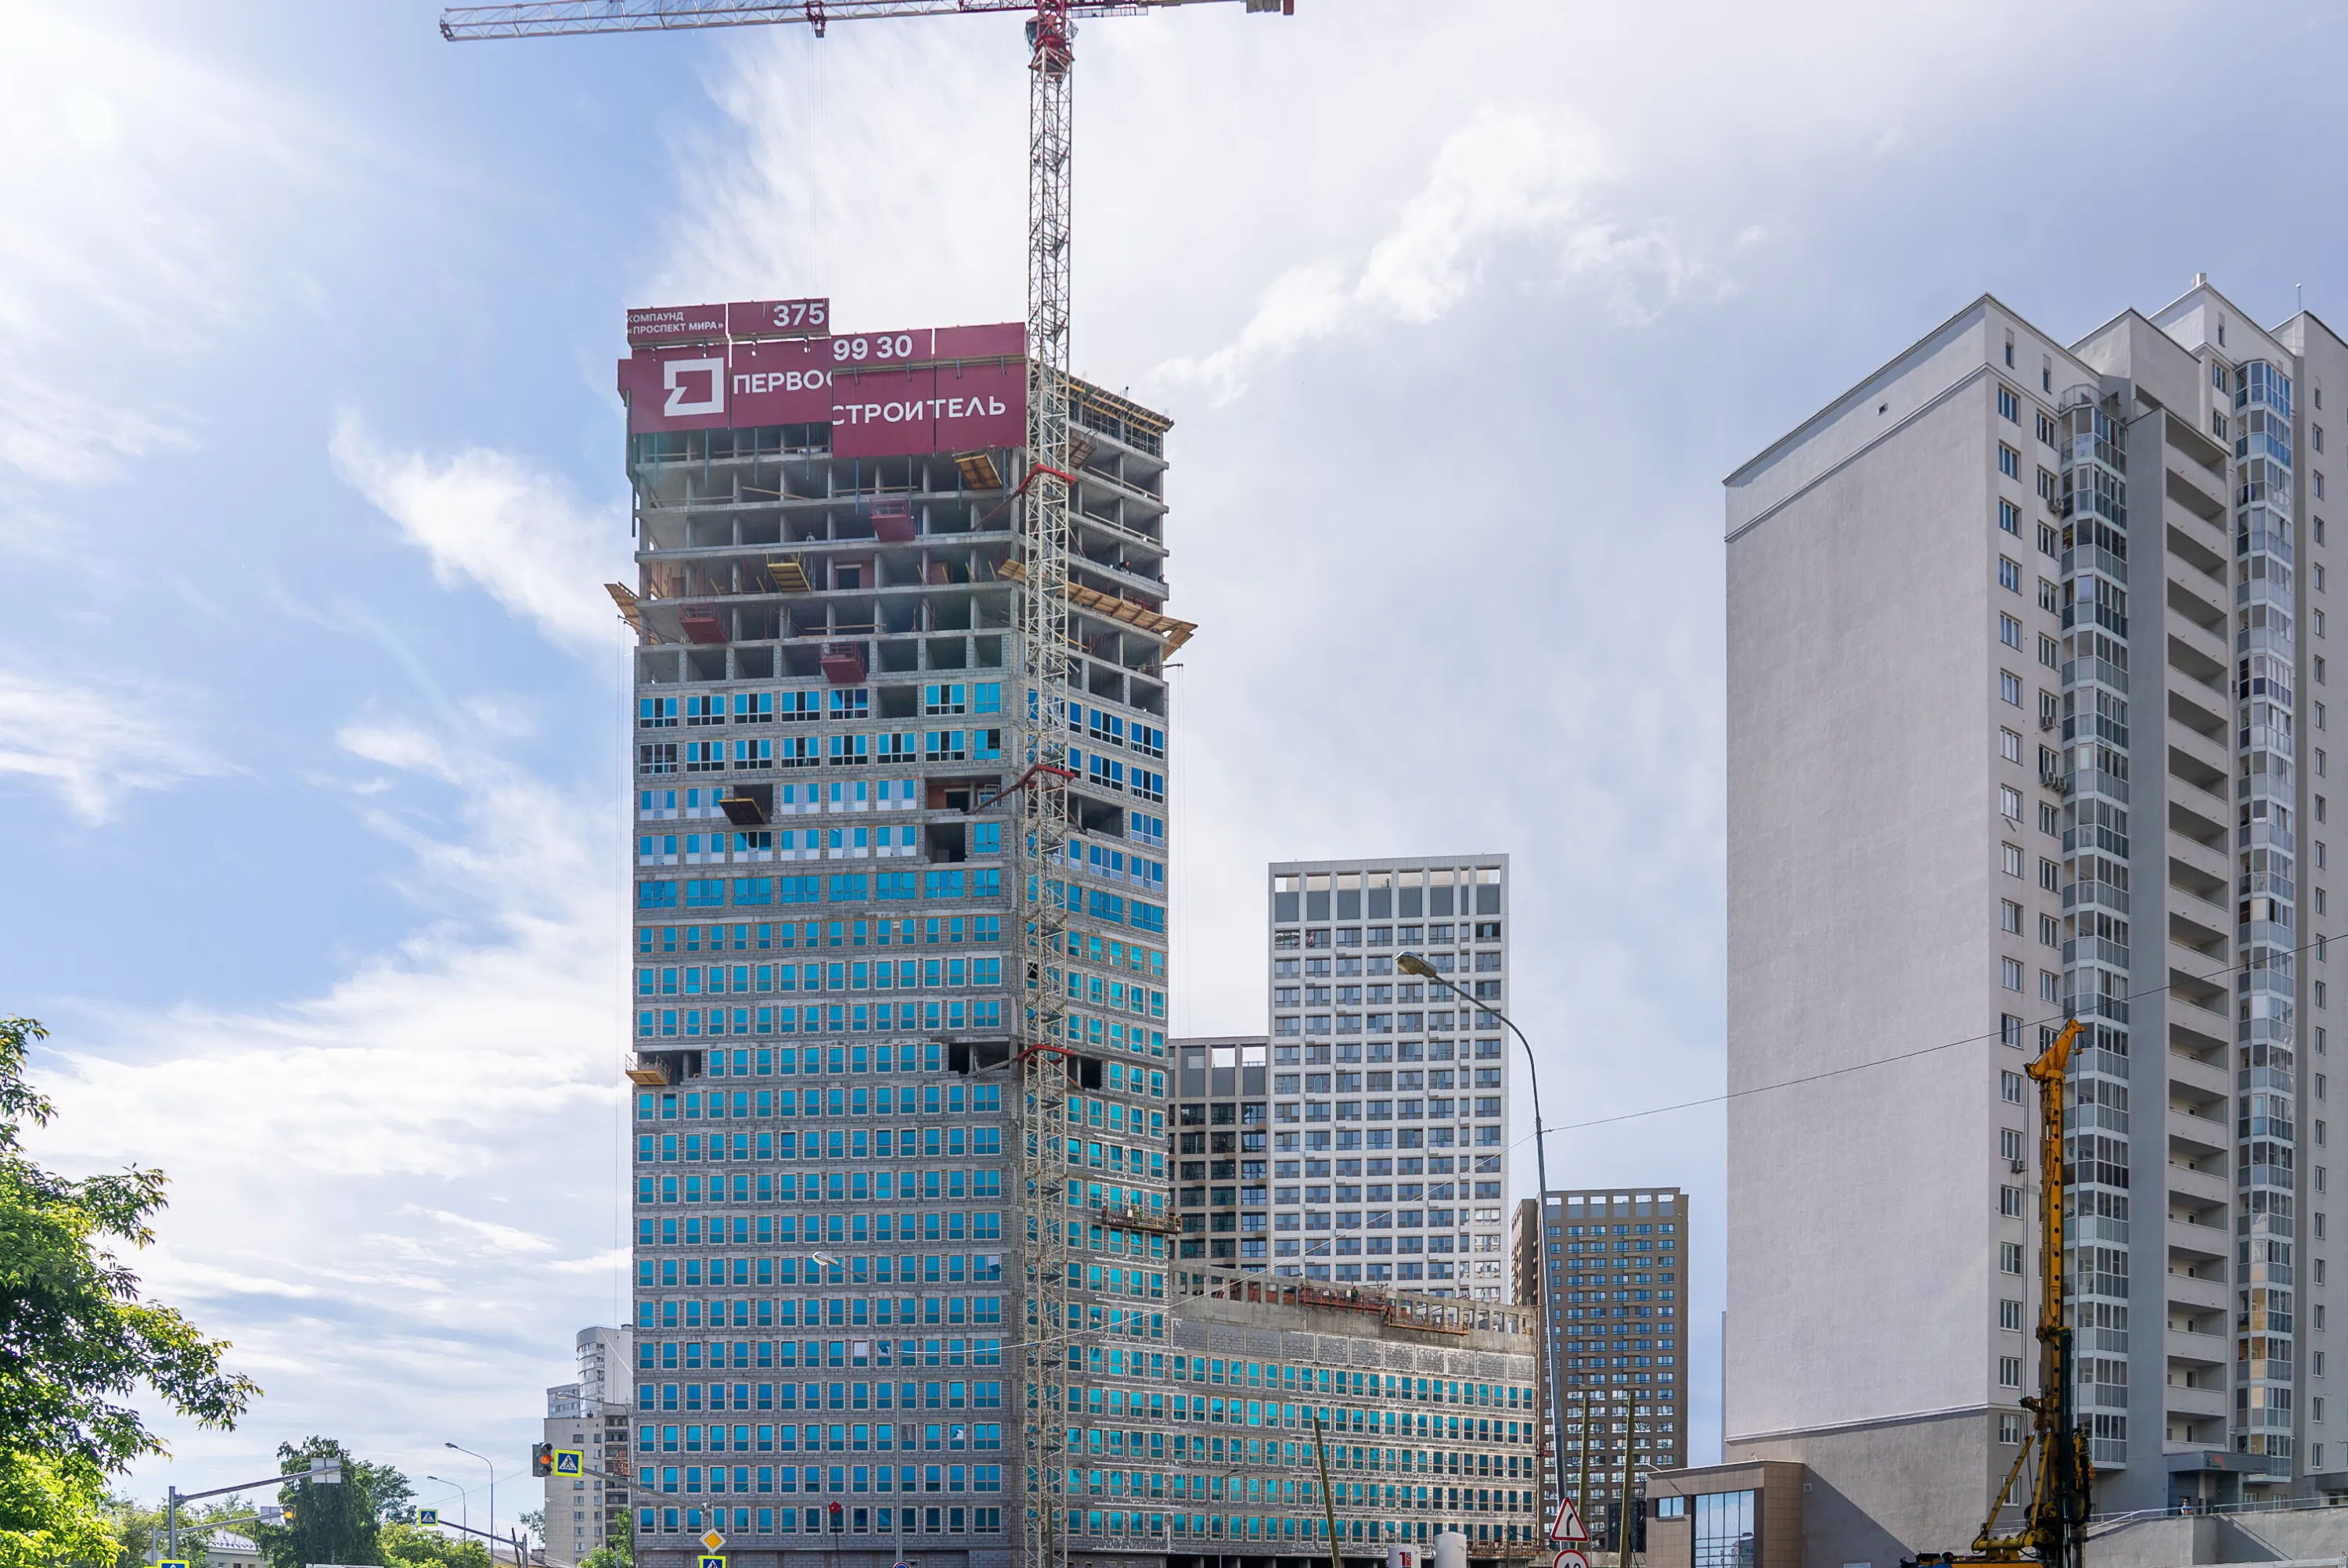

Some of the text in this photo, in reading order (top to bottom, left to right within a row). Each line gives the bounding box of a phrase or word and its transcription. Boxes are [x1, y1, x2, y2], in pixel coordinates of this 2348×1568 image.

[689, 321, 724, 331] МИРА»
[772, 303, 825, 327] 375
[833, 335, 913, 361] 99 30
